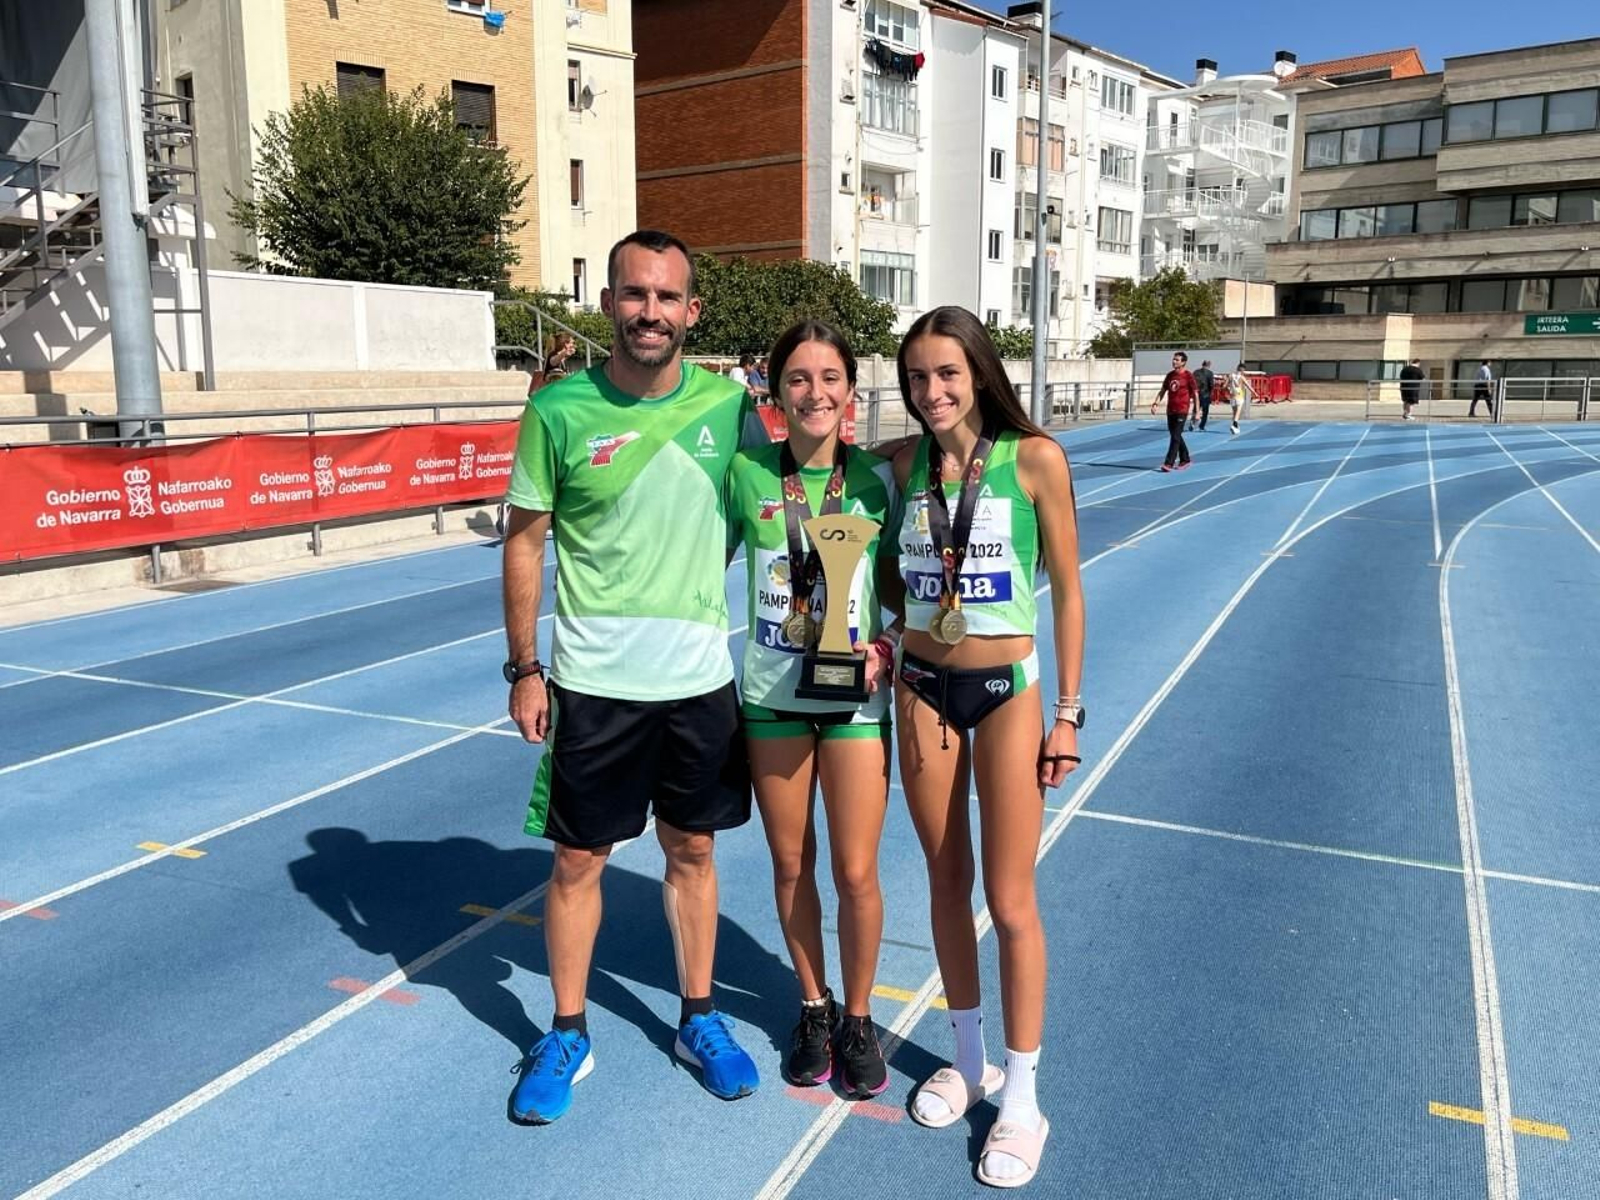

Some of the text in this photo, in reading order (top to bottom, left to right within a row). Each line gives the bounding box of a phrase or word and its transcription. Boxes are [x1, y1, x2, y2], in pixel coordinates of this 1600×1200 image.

[337, 462, 392, 479] Nafarroako
[415, 457, 456, 470] Gobierno
[157, 476, 232, 496] Nafarroako
[260, 472, 310, 487] Gobierno
[338, 481, 386, 494] Gobernua
[410, 472, 455, 486] de Navarra
[46, 488, 121, 506] Gobierno
[250, 488, 314, 505] de Navarra
[160, 496, 224, 515] Gobernua
[36, 507, 121, 528] de Navarra
[969, 543, 1003, 558] 2022
